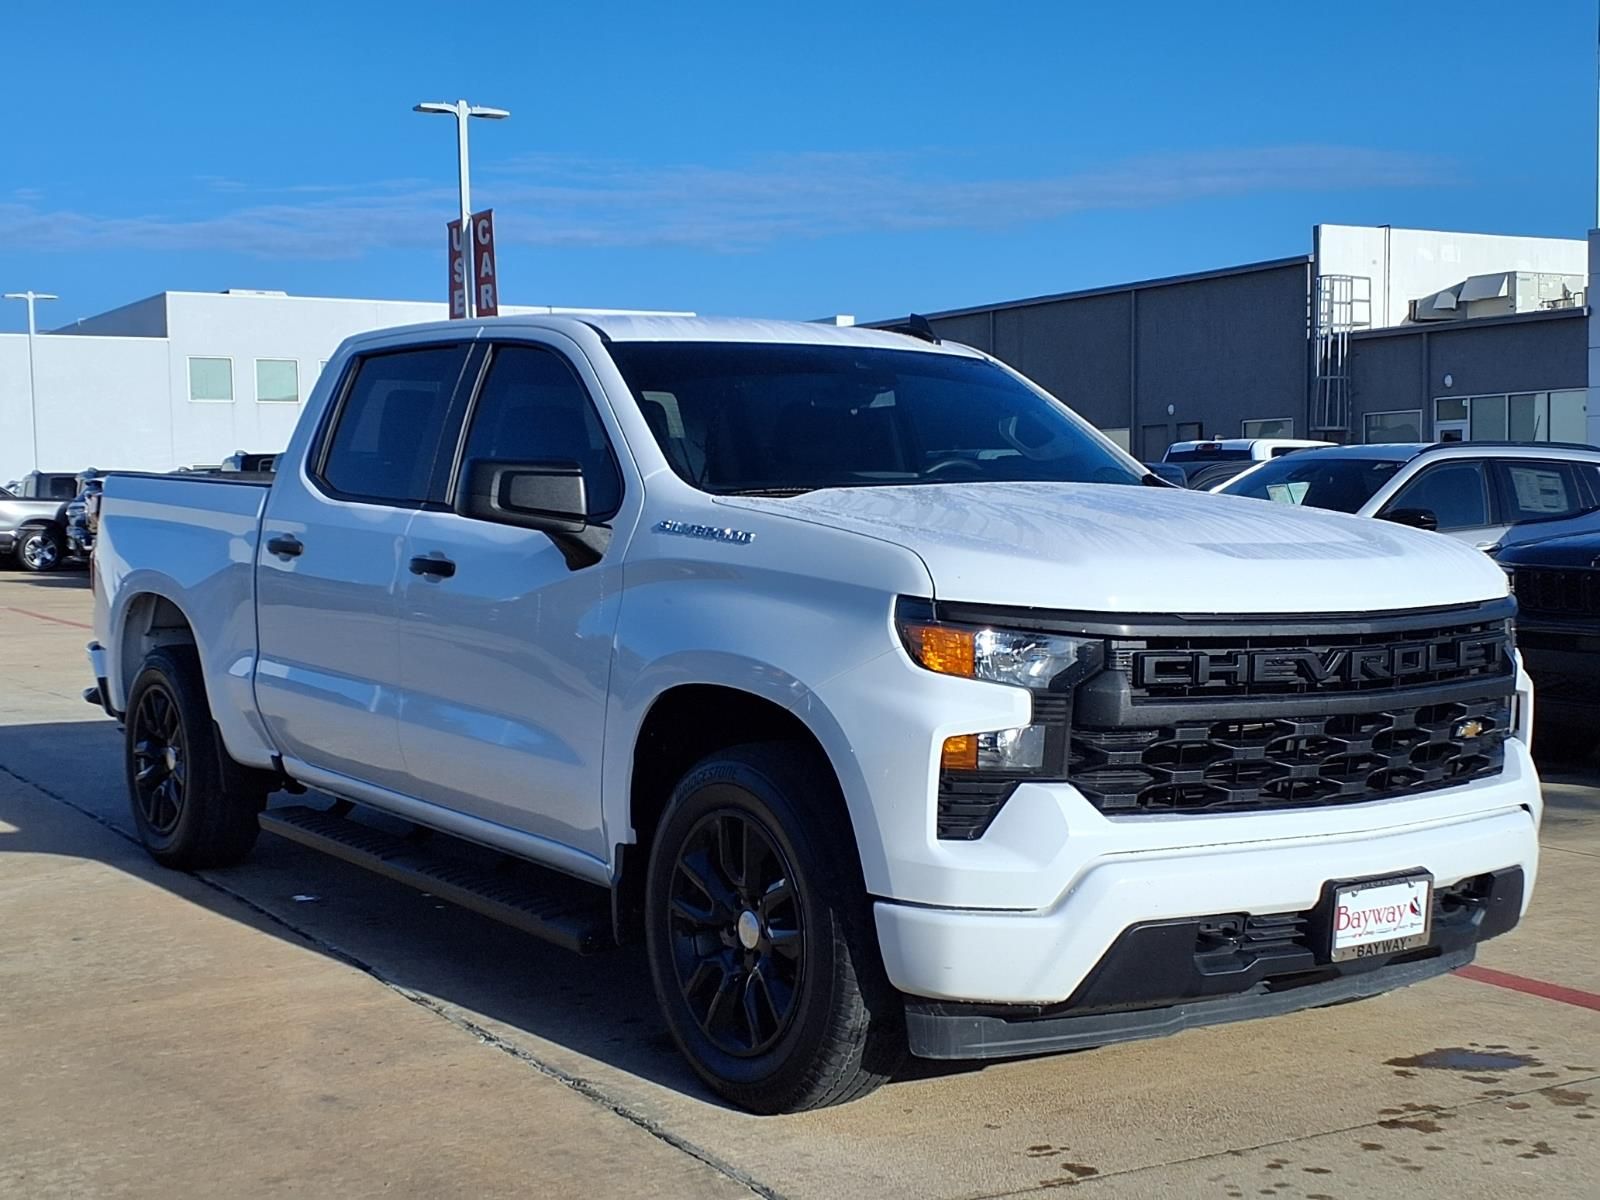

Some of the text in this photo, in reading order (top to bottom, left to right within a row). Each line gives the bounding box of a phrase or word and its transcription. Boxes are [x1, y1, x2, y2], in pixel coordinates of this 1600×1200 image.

[477, 218, 494, 310] CAR
[1335, 904, 1407, 937] Bayway
[1356, 938, 1408, 958] BAYWAY
